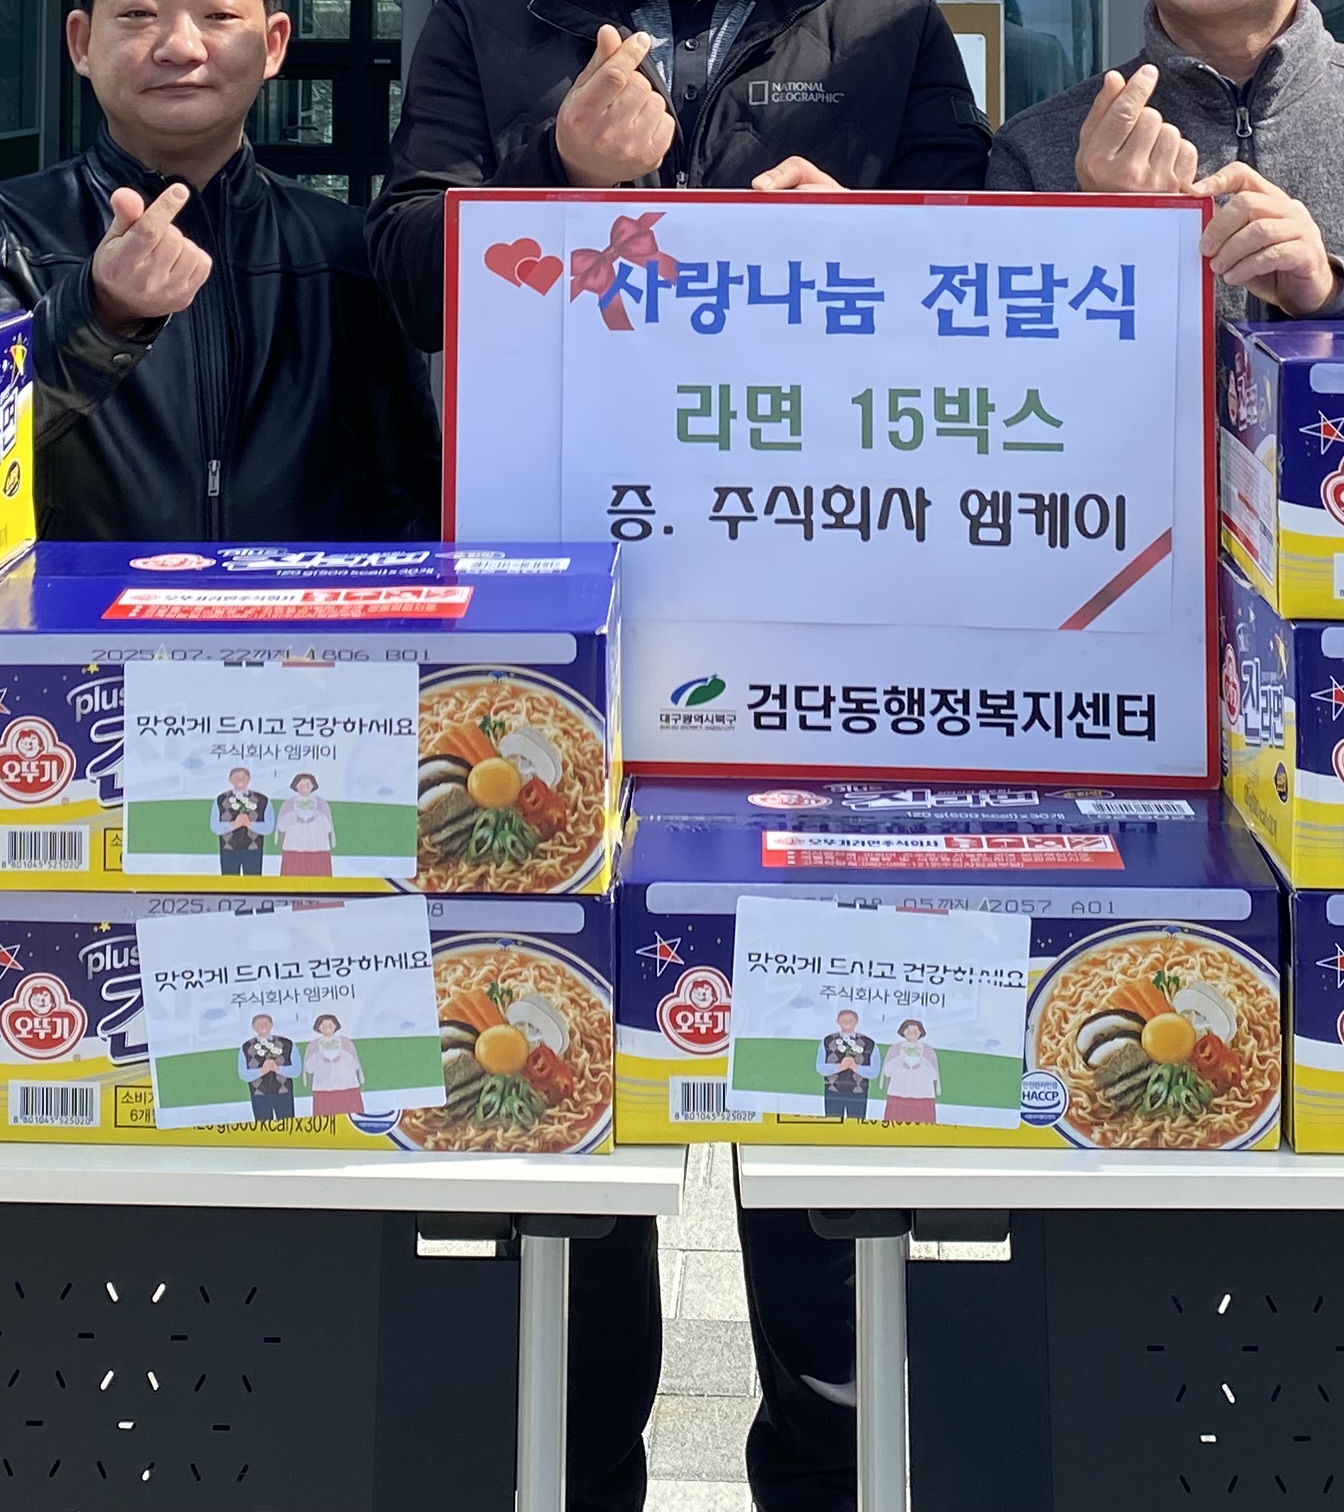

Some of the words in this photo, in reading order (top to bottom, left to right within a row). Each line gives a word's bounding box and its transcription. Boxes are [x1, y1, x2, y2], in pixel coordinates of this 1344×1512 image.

[772, 82, 825, 94] NATIONAL
[598, 259, 886, 336] 사랑나눔
[920, 262, 1138, 341] 전달식
[675, 383, 804, 453] 라면
[850, 383, 1066, 455] 15박스
[606, 484, 675, 541] 증.
[707, 484, 931, 542] 주식회사
[959, 487, 1127, 551] 엠케이
[385, 648, 431, 661] B01
[660, 713, 736, 724] 대구광역시북구
[747, 682, 1157, 743] 검단동행정복지센터
[135, 714, 211, 737] 맛있게
[215, 715, 287, 737] 드시고
[292, 715, 416, 737] 건강하세요
[208, 742, 281, 762] 주식회사
[284, 742, 338, 762] 엠케이
[0, 757, 62, 783] 오뚜기
[989, 899, 1053, 914] 2057
[1070, 900, 1116, 915] A01
[154, 965, 229, 992] 맛있게
[233, 958, 302, 984] 드시고
[307, 950, 432, 981] 건강하세요
[747, 951, 822, 976] 맛있게
[826, 955, 896, 981] 드시고
[902, 961, 1027, 988] 건강하세요
[229, 988, 300, 1009] 주식회사
[302, 983, 356, 1002] 엠케이
[819, 984, 890, 1004] 주식회사
[892, 989, 946, 1008] 엠케이
[14, 1017, 70, 1041] 오뚜기
[674, 1011, 730, 1035] 오뚜기
[1022, 1091, 1059, 1101] HACCP
